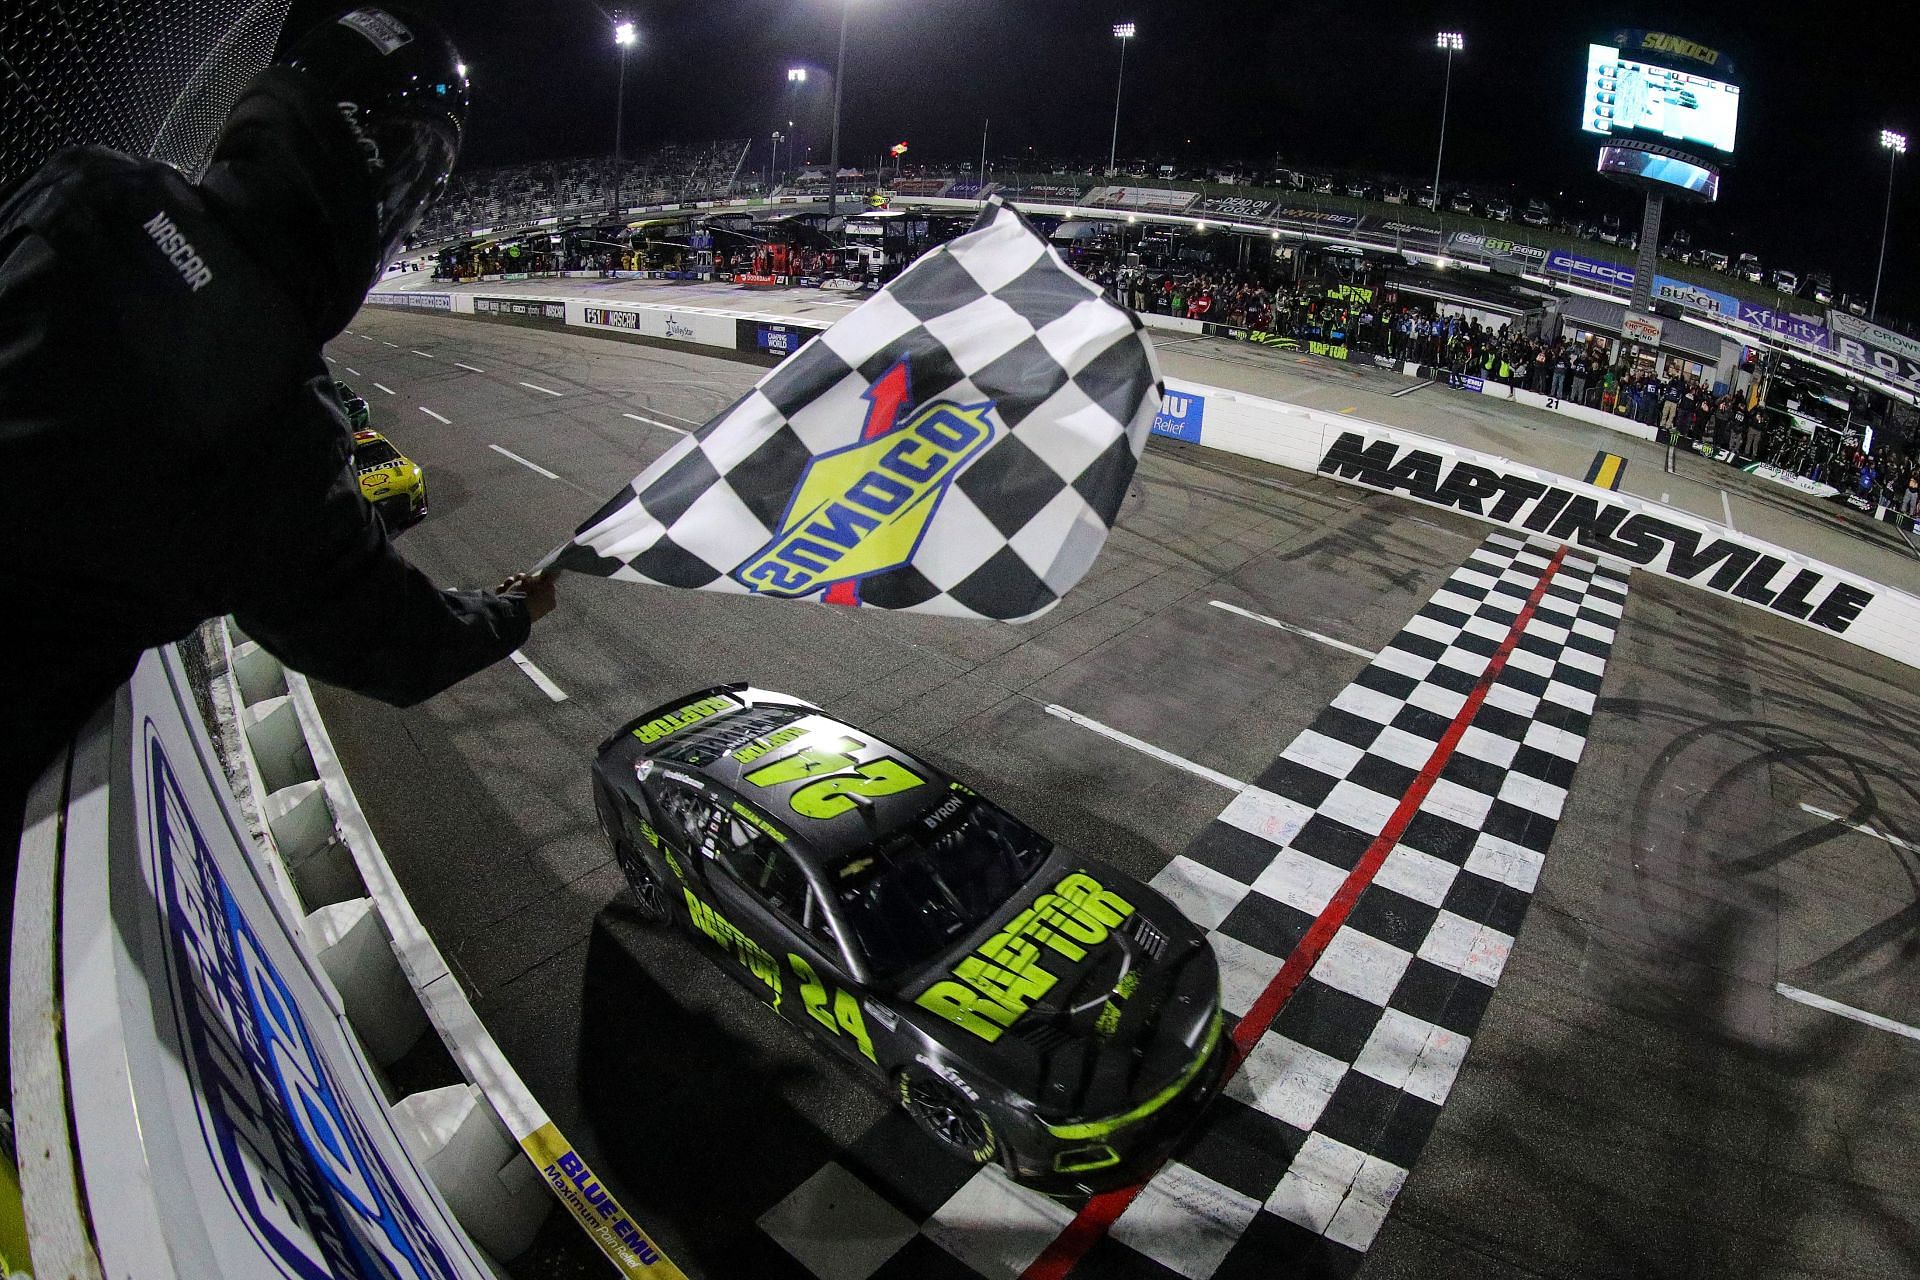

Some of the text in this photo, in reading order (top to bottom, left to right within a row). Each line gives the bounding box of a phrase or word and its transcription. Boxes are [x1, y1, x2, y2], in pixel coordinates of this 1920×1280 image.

[1641, 32, 1718, 65] SUNOCO
[1215, 205, 1262, 216] TOOLS
[1221, 196, 1272, 209] DEAD ON
[143, 210, 213, 292] NASCAR
[1553, 256, 1636, 283] GEICO
[1660, 286, 1721, 312] BUSCH
[586, 307, 636, 329] FS1 NASCAR
[1744, 307, 1826, 344] xfinity
[1250, 330, 1267, 342] 24
[1309, 341, 1349, 360] RAPTOR
[1545, 398, 1559, 410] 21
[1154, 416, 1186, 435] Relief
[1715, 450, 1736, 463] 31
[1318, 431, 1876, 634] MARTINSVILLE
[632, 695, 733, 744] RAPTOR
[743, 735, 928, 820] 24
[925, 797, 964, 829] BYRON
[916, 872, 1137, 1043] RAPTOR
[787, 953, 881, 1065] 24
[543, 1163, 642, 1270] Maximum Pain Relief
[556, 1150, 661, 1266] BLUE-EMU
